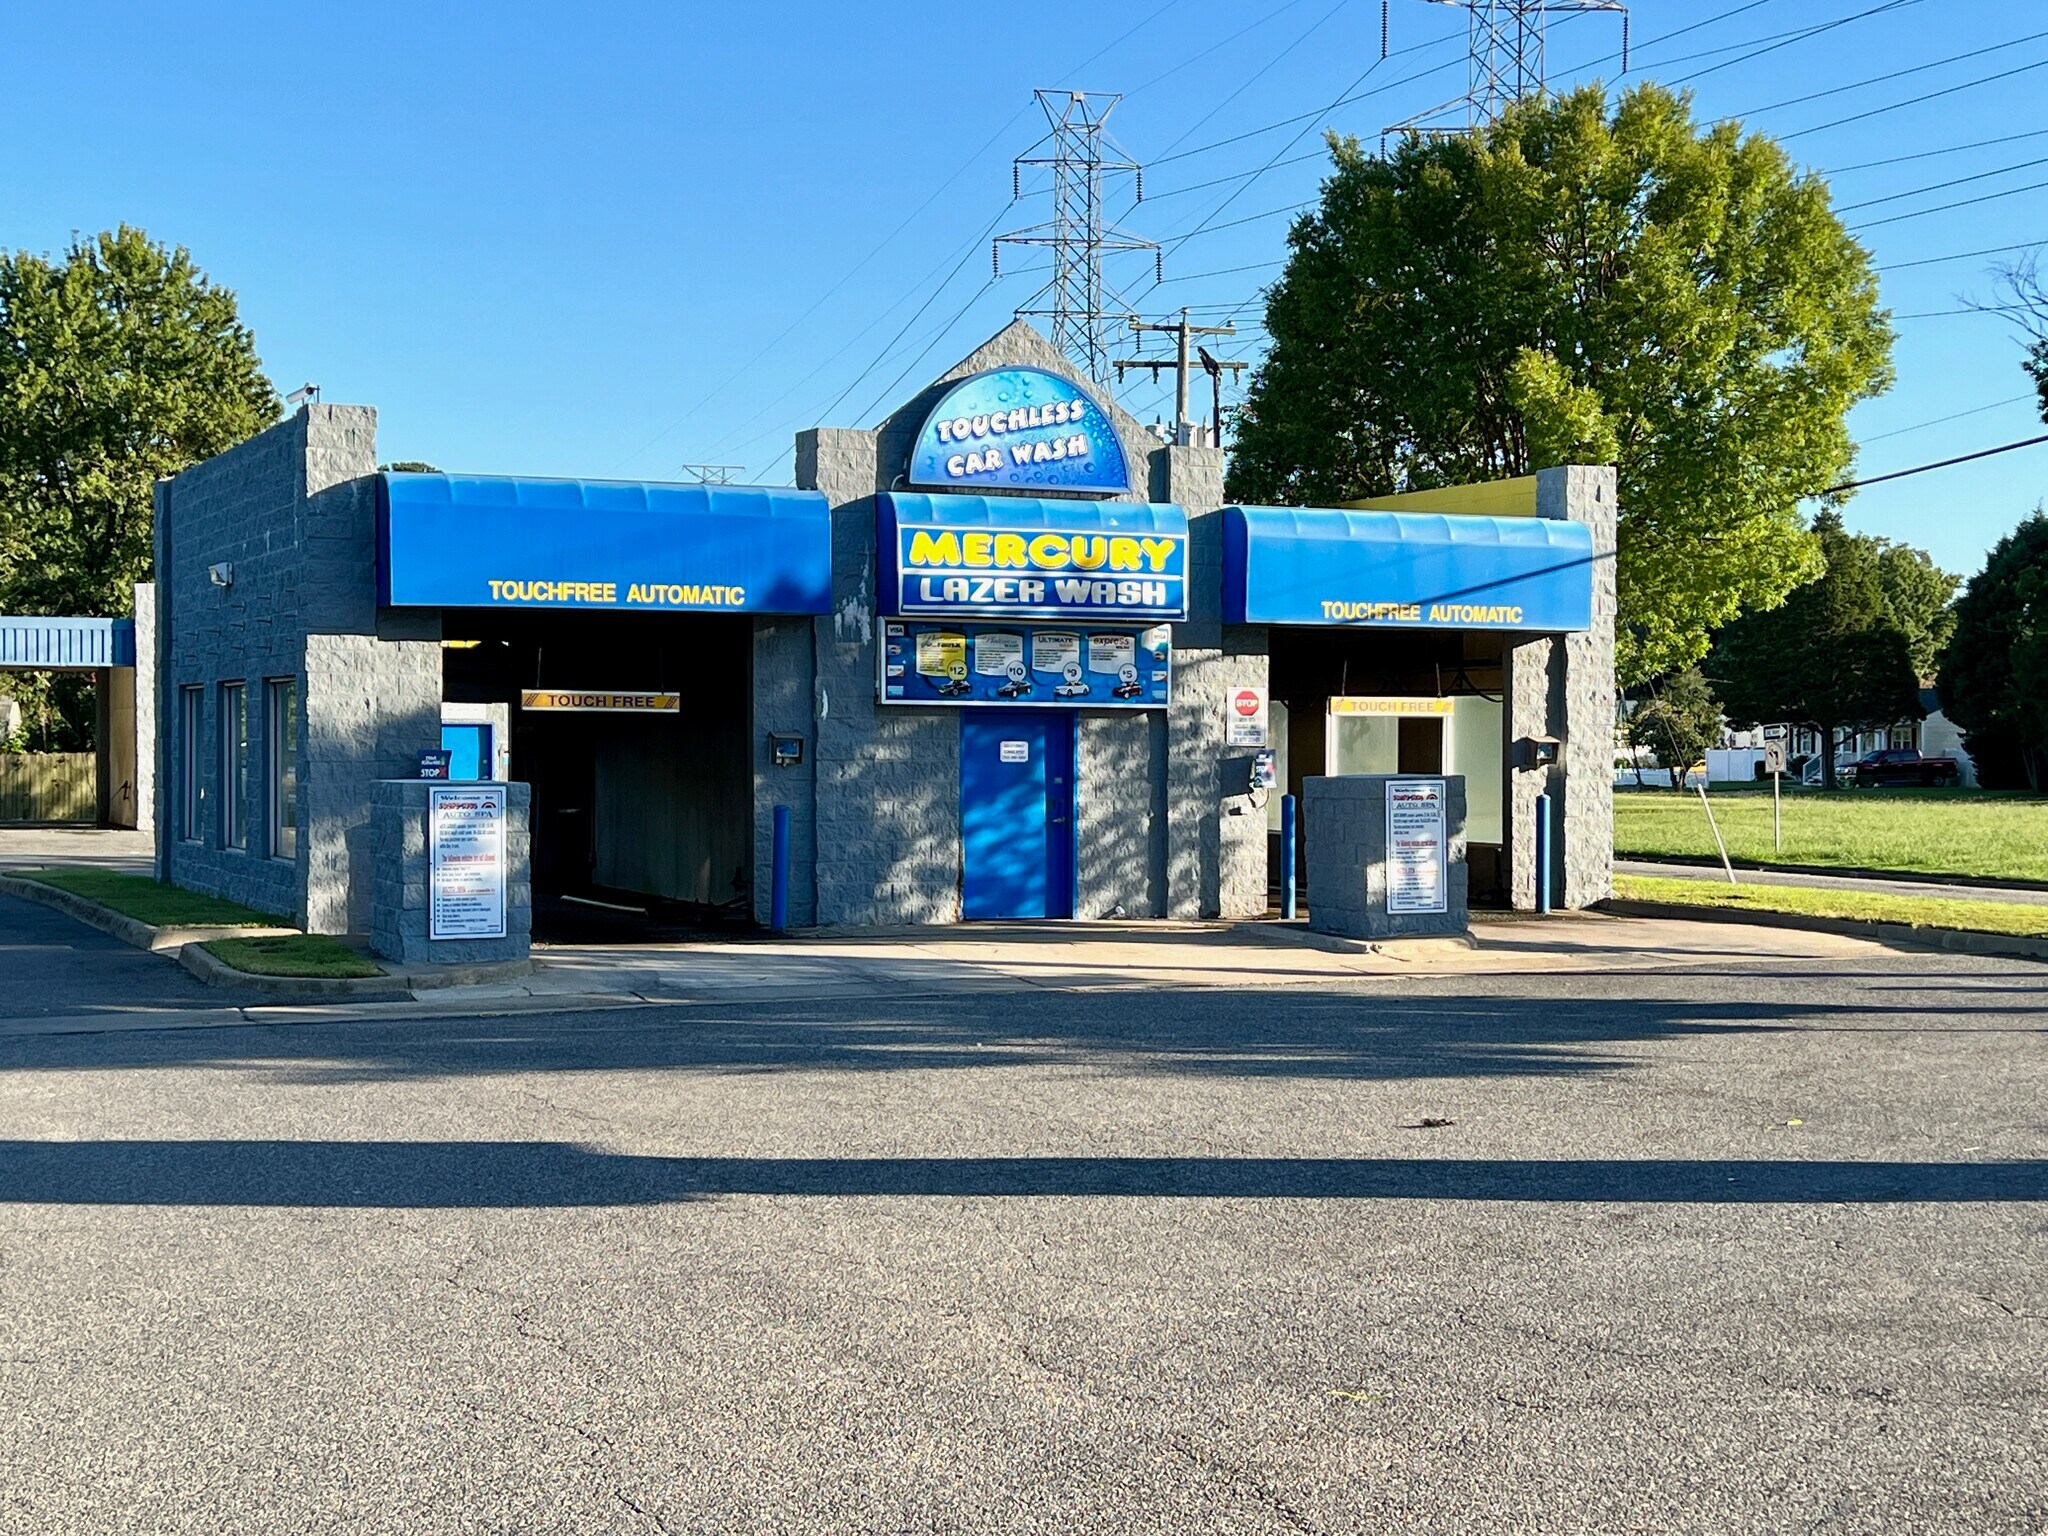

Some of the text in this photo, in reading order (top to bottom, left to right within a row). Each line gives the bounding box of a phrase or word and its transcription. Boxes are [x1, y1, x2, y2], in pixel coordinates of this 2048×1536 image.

[937, 398, 1084, 442] TOUCHLESS
[947, 434, 1088, 477] CAR WASH
[909, 531, 1176, 572] MERCURY
[488, 580, 746, 606] TOUCHFREE AUTOMATIC
[920, 577, 1166, 606] LAZER WASH
[1321, 601, 1523, 624] TOUCHFREE AUTOMATIC
[1093, 637, 1130, 646] express
[949, 666, 965, 676] $12
[1009, 667, 1024, 676] $10
[1066, 668, 1078, 678] $9
[1122, 669, 1133, 679] $5
[548, 694, 656, 709] TOUCH FREE
[1236, 698, 1258, 708] STOP
[1351, 701, 1435, 713] TOUCH FREE
[420, 768, 440, 778] STOP
[443, 811, 471, 819] AUTO
